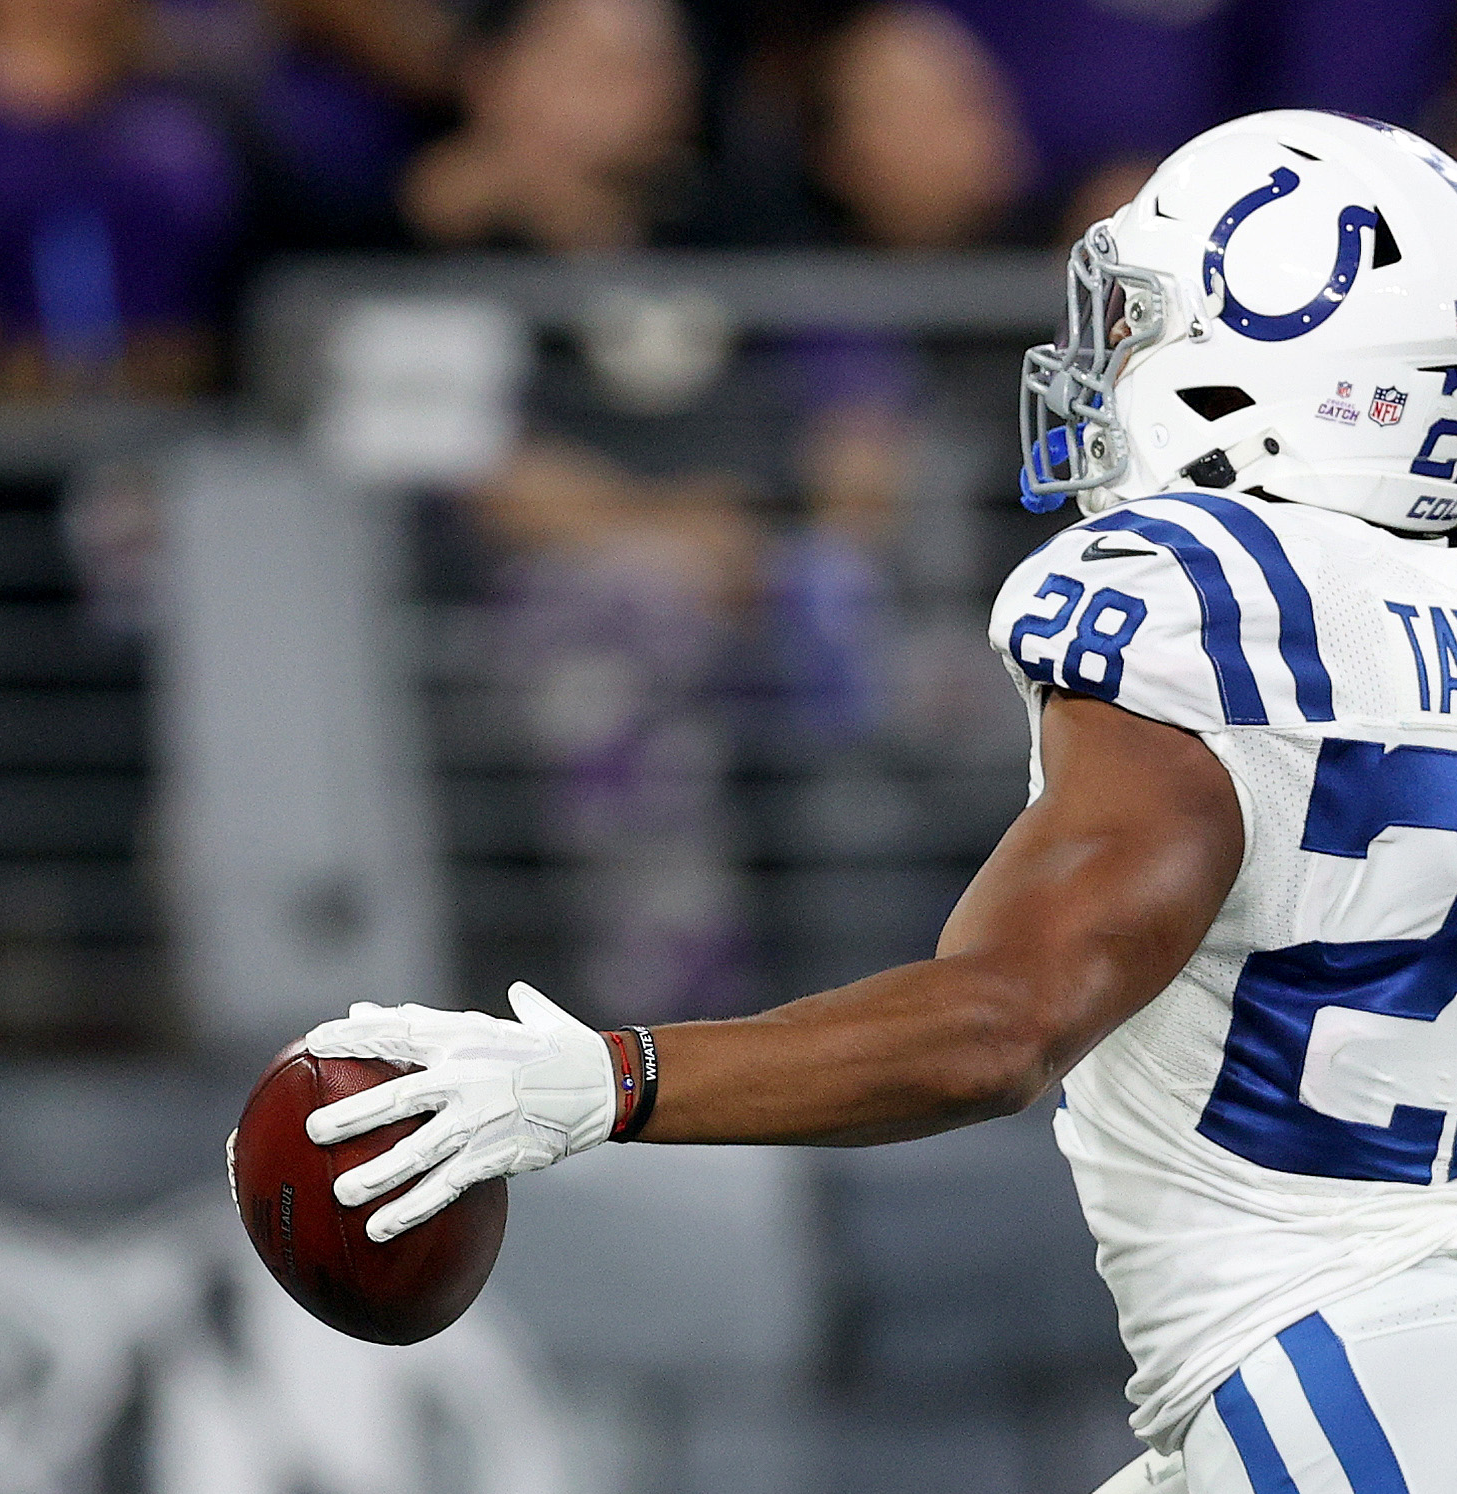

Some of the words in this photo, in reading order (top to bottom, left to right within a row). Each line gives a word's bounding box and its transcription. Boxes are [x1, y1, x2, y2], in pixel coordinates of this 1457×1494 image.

[1317, 403, 1360, 422] CATCH
[1371, 400, 1399, 423] NFL
[1009, 572, 1148, 702] 28
[281, 1183, 293, 1241] LEAGUE
